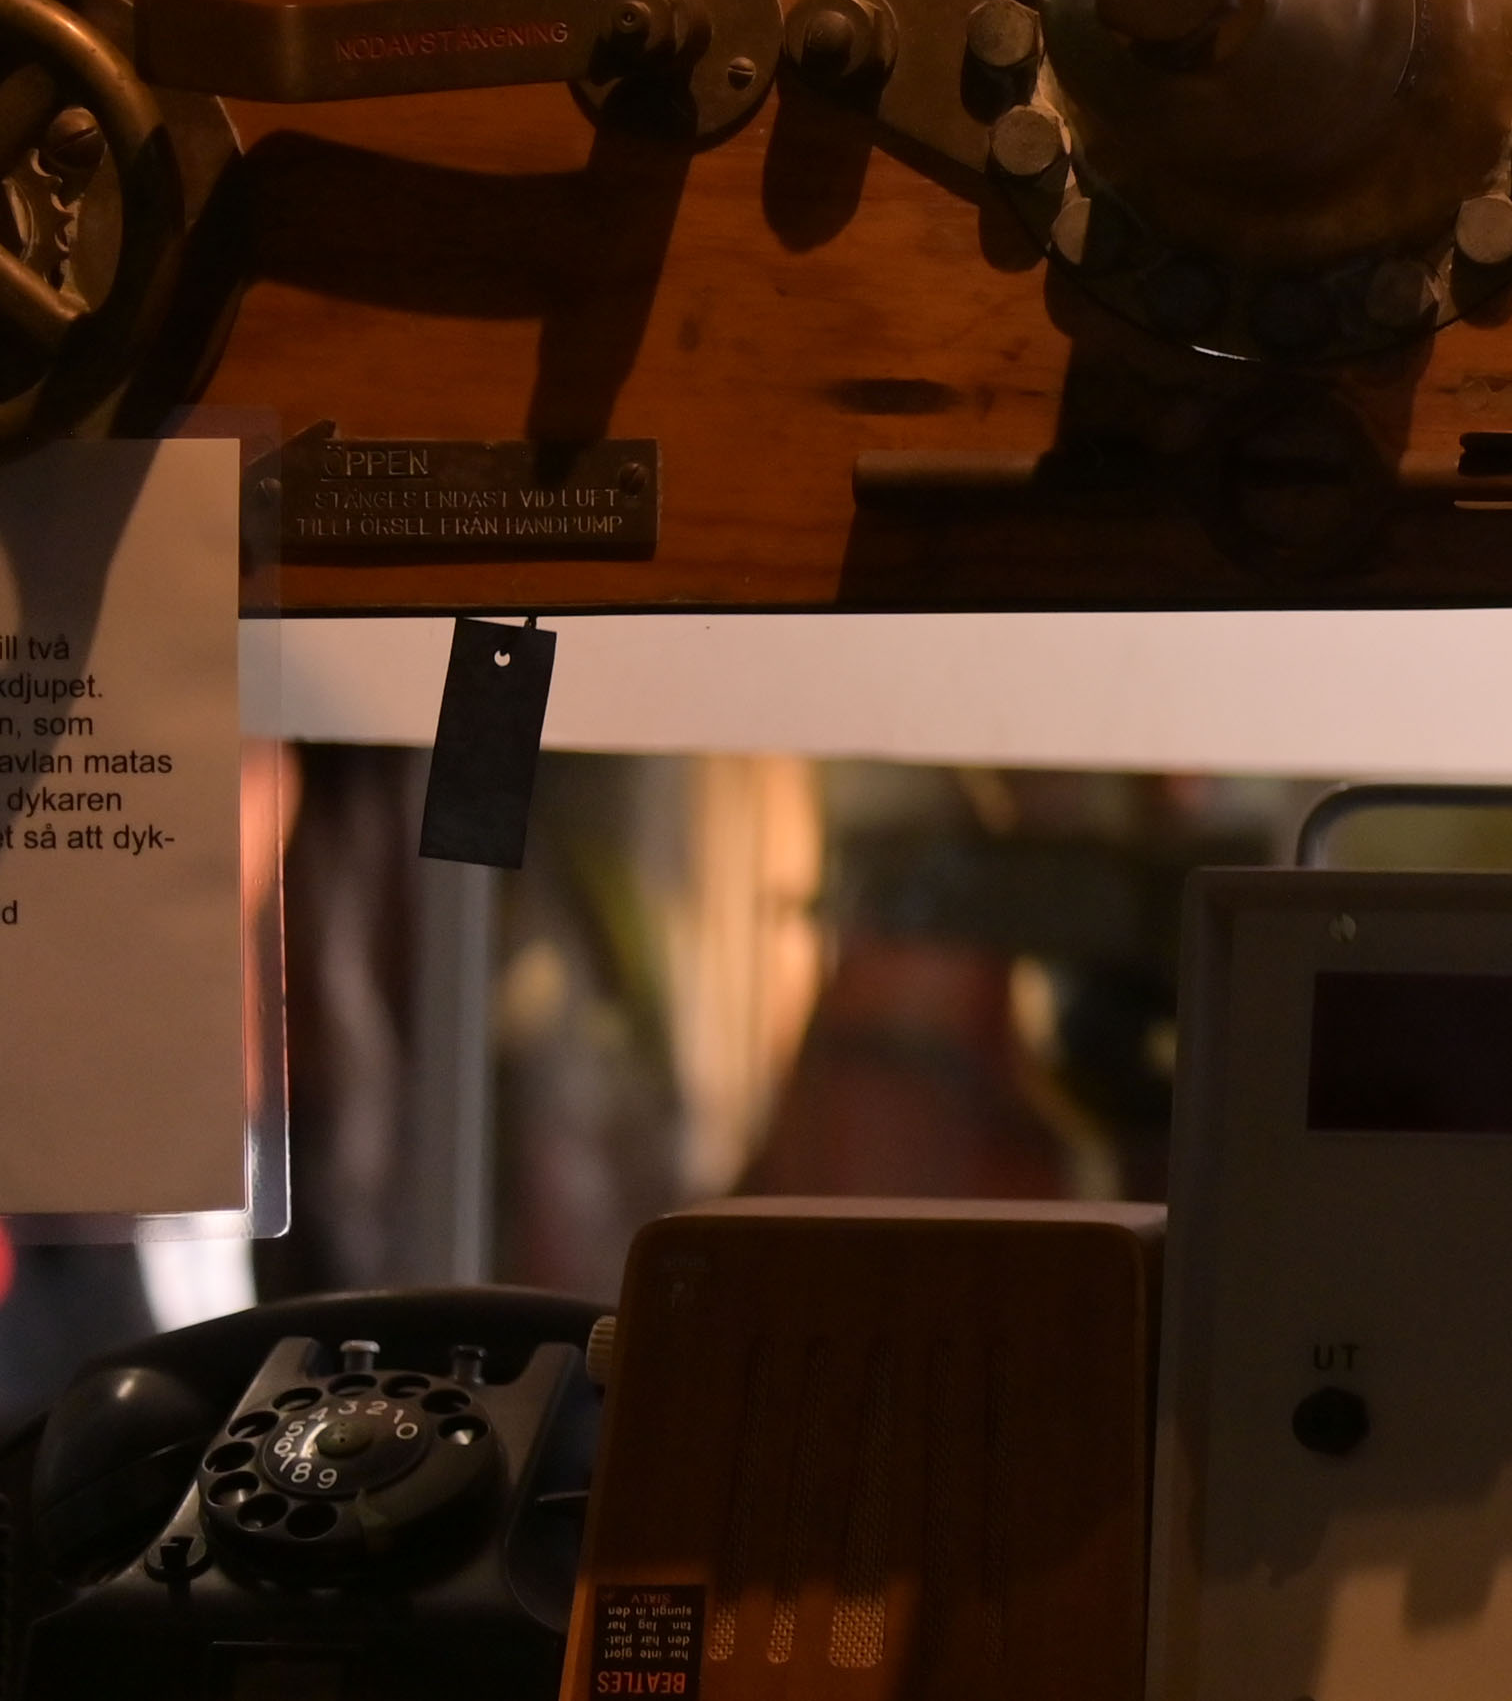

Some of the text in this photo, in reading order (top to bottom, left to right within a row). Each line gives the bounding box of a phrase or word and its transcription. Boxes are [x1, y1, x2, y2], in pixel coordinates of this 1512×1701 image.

[322, 444, 430, 476] ÖPPEN
[519, 489, 555, 507] VID
[28, 634, 70, 660] två
[33, 717, 93, 736] som
[84, 753, 173, 774] matas
[7, 788, 122, 816] dykaren
[24, 824, 175, 856] så att dyk-
[1313, 1344, 1359, 1371] UT
[291, 1422, 418, 1483] 0 8
[608, 1606, 692, 1617] sjungit den
[604, 1649, 662, 1660] inte gjort
[597, 1671, 686, 1694] BEATLES
